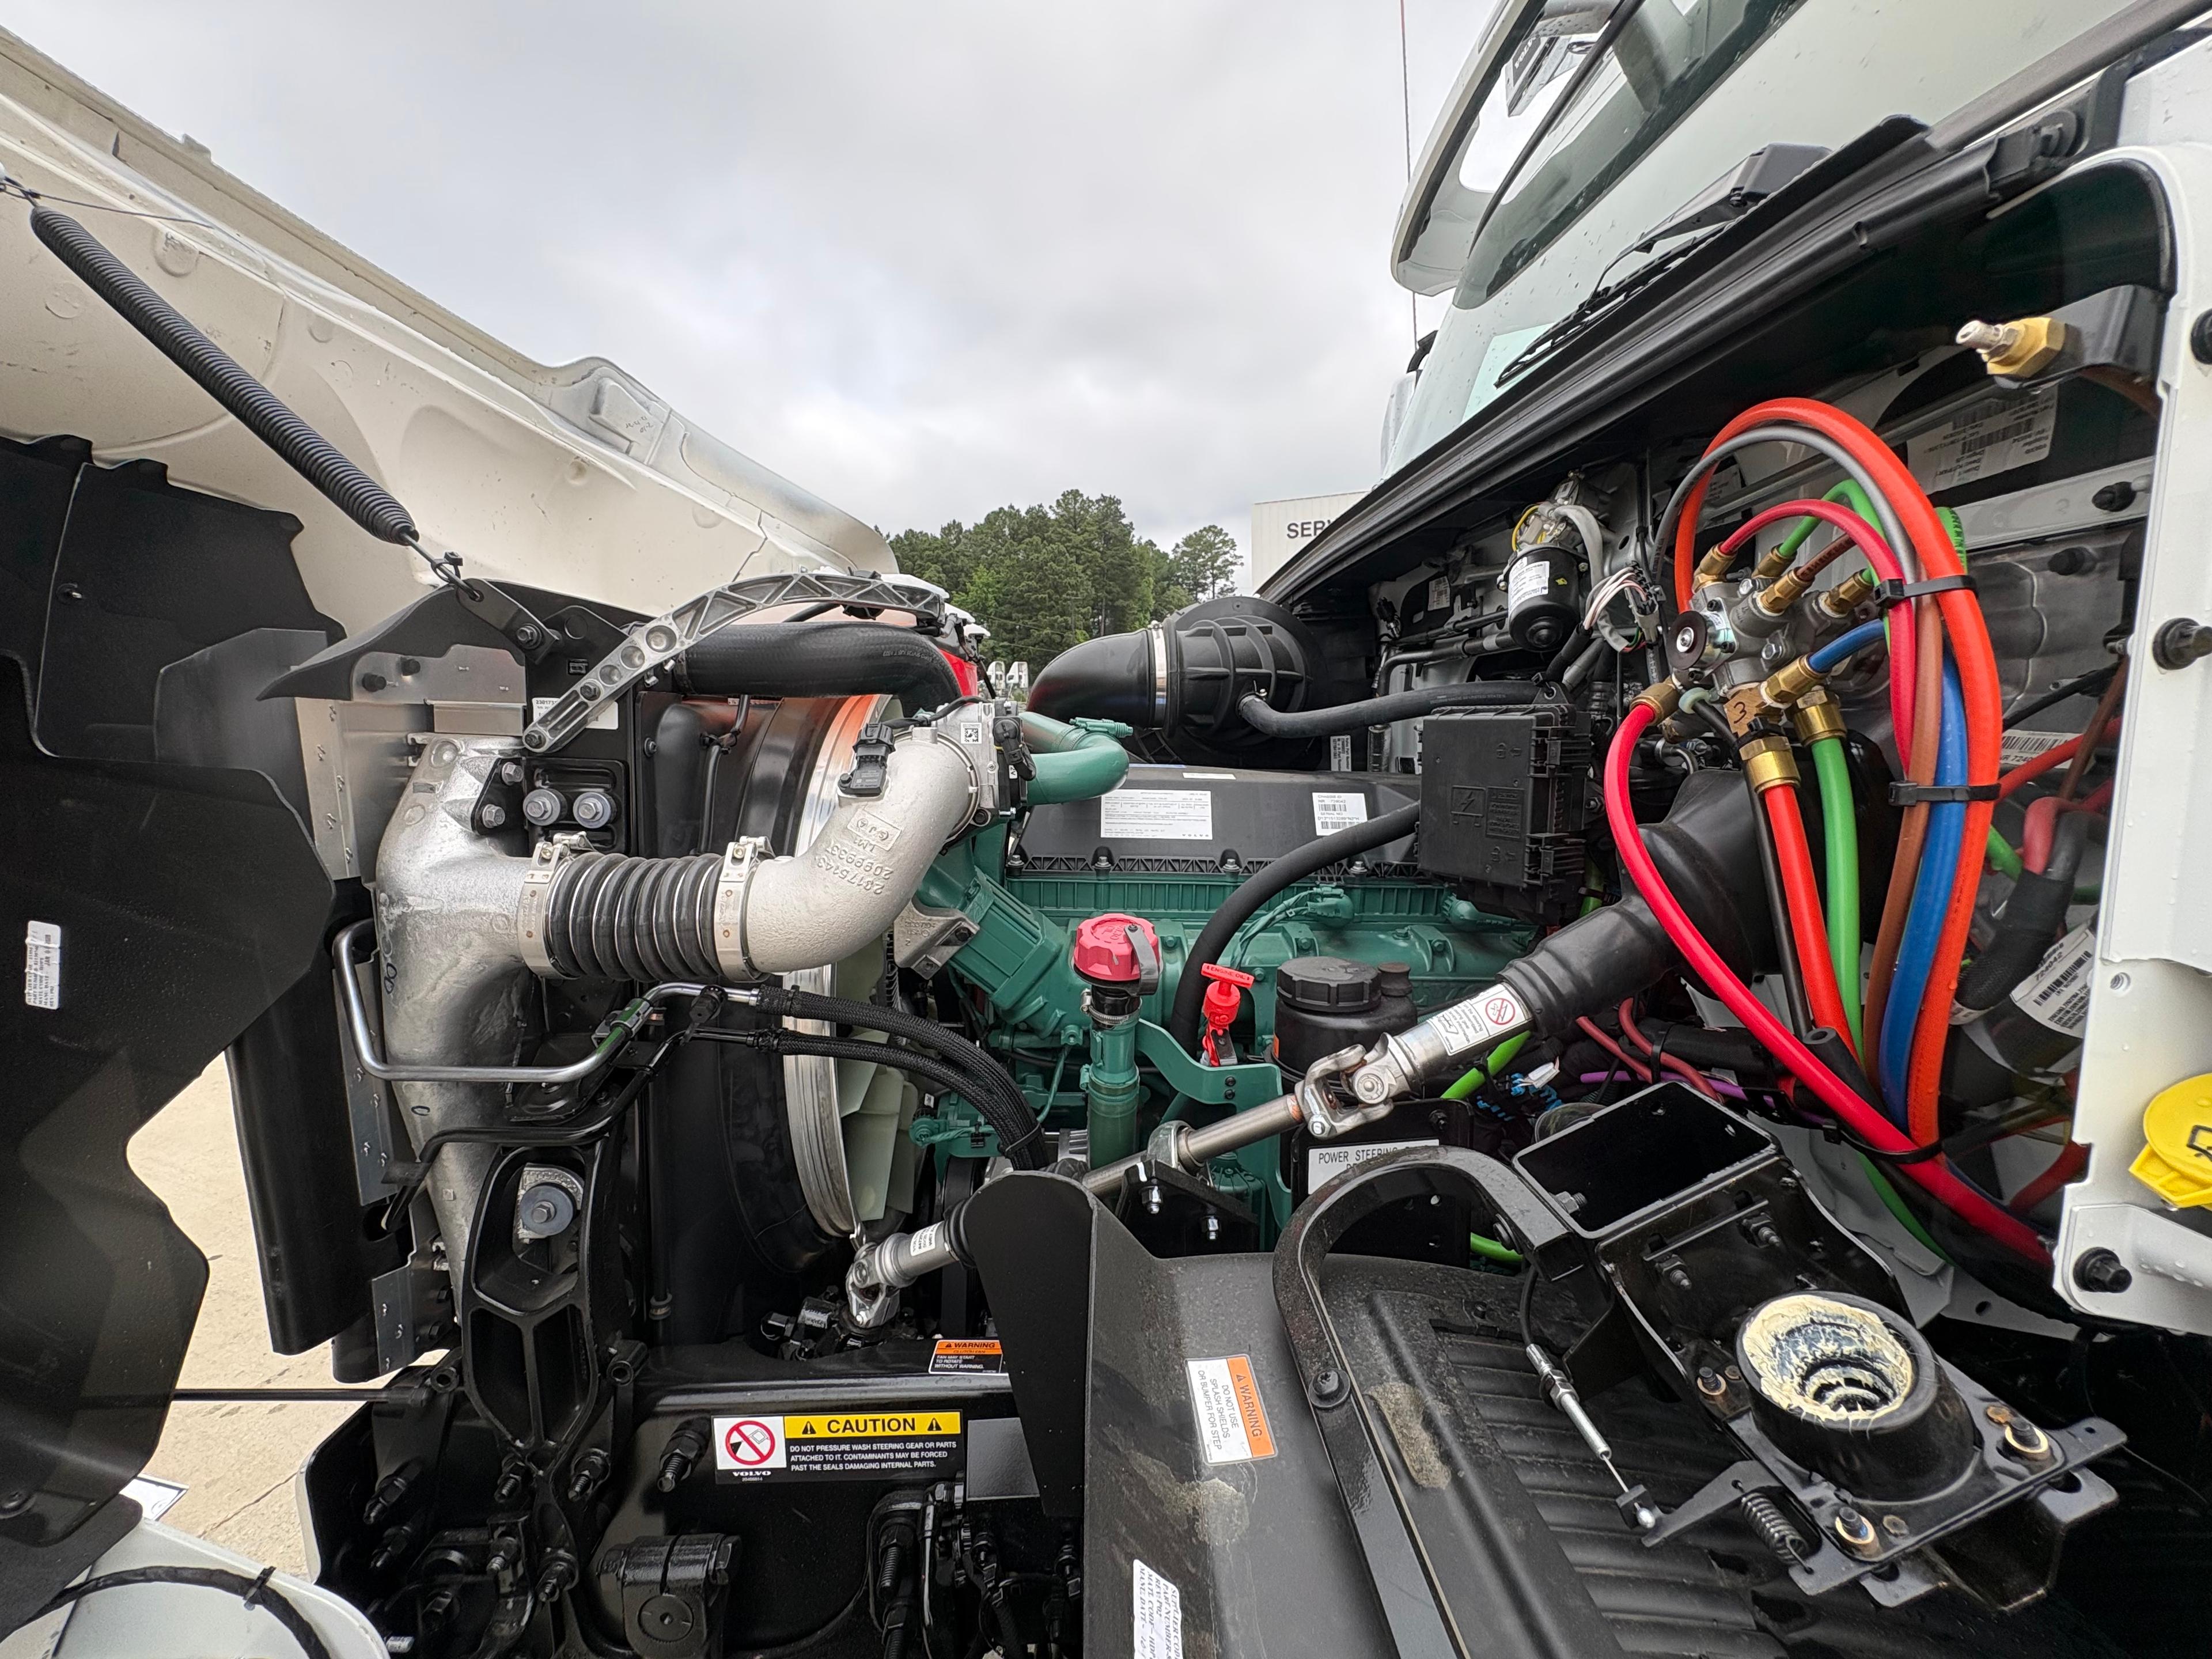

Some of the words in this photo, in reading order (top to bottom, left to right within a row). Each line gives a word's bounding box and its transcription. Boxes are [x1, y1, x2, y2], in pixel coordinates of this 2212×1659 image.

[1287, 520, 1331, 539] SER
[1734, 702, 1747, 724] 3
[1319, 1151, 1349, 1164] POWER
[1198, 1370, 1206, 1380] OR
[1200, 1382, 1213, 1411] BUMPER
[1222, 1385, 1230, 1396] DO
[1210, 1378, 1222, 1406] SPLASH
[1217, 1407, 1230, 1438] SHIELDS
[1225, 1396, 1235, 1411] NOT
[1240, 1385, 1262, 1437] WARNING
[827, 1418, 915, 1433] CAUTION
[1207, 1412, 1217, 1428] FOR
[1229, 1413, 1238, 1429] USE
[816, 1444, 850, 1452] PRESSURE
[1211, 1430, 1222, 1450] STEP
